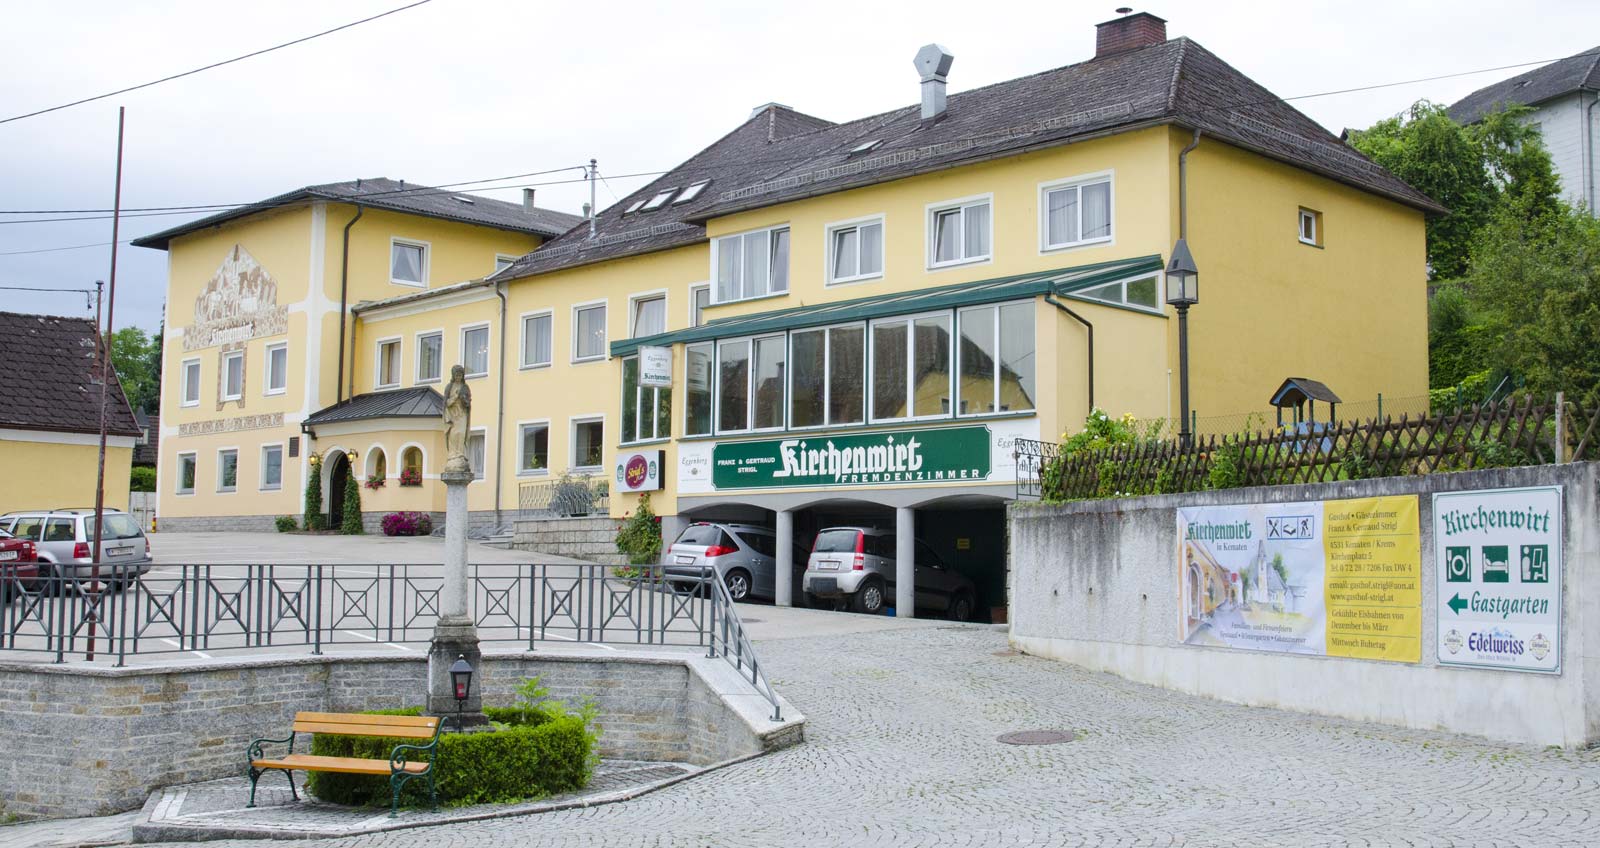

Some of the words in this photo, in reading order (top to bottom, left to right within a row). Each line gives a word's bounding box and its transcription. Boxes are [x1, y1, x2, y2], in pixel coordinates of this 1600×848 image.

[717, 458, 736, 466] FRANZ
[745, 457, 776, 465] GERTRAUD
[772, 435, 923, 483] Kirchenwirt
[737, 466, 758, 474] STRIGL
[841, 469, 980, 483] FREMDENZIMMER
[1328, 524, 1345, 533] Franz
[1380, 522, 1398, 532] Strigl
[1441, 505, 1551, 536] Kirchenwirt
[1185, 519, 1252, 544] Kirchenwirt
[1382, 564, 1393, 572] Fax
[1471, 590, 1549, 620] Gastgarten
[1468, 632, 1525, 656] Edelweiss
